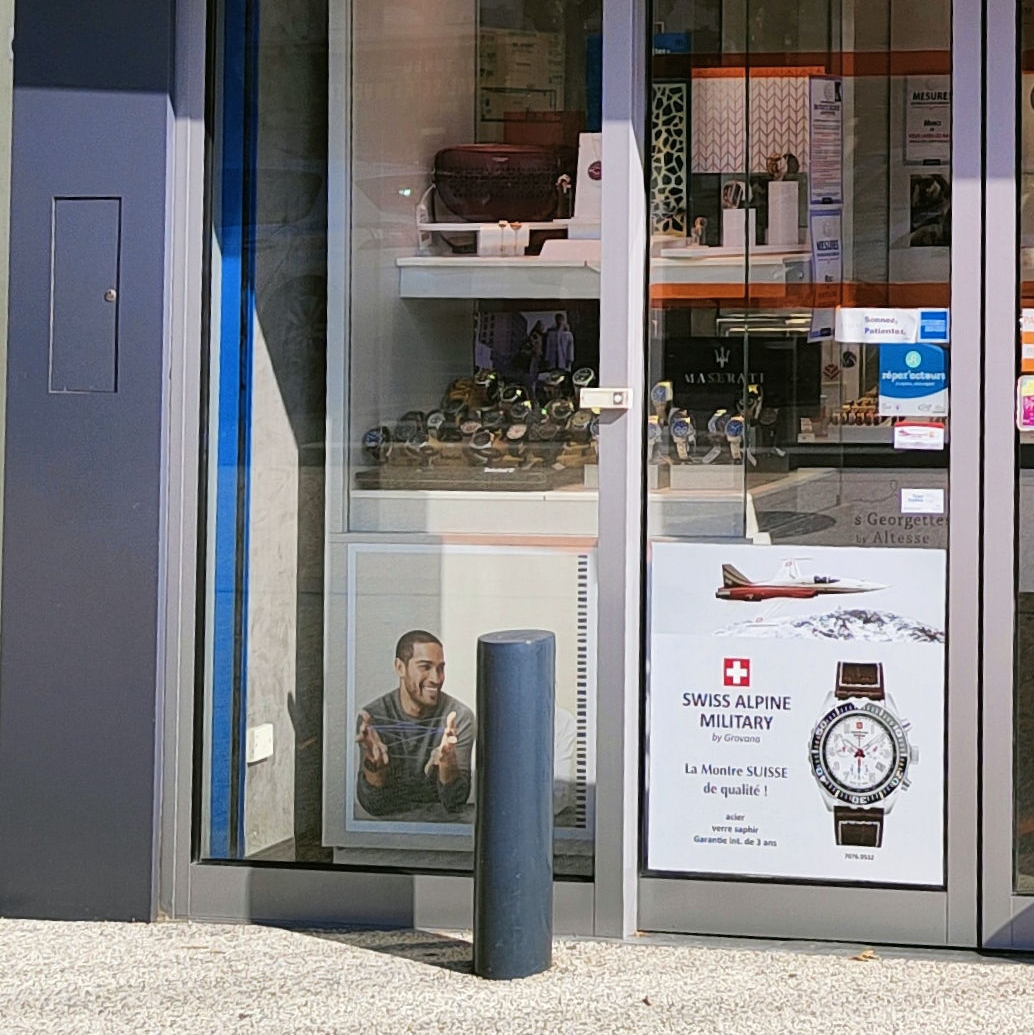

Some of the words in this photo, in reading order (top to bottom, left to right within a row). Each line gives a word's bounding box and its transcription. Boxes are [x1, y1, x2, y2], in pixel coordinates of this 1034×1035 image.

[912, 91, 951, 101] MESURE
[684, 372, 766, 384] MASERATI
[866, 511, 949, 530] Georgette
[872, 529, 930, 544] Altesse
[682, 692, 731, 708] SWISS
[735, 694, 791, 710] ALPINE
[700, 713, 773, 730] MILITARY
[711, 732, 722, 743] by
[723, 733, 761, 744] Grovana
[685, 762, 698, 775] La
[701, 763, 744, 777] Montre
[746, 765, 788, 779] SUISSE
[703, 781, 718, 794] de
[720, 783, 761, 799] qualité
[725, 812, 746, 822] acier
[711, 825, 732, 833] verre
[734, 825, 759, 835] saphir
[693, 835, 727, 845] Garantie
[744, 838, 755, 846] de
